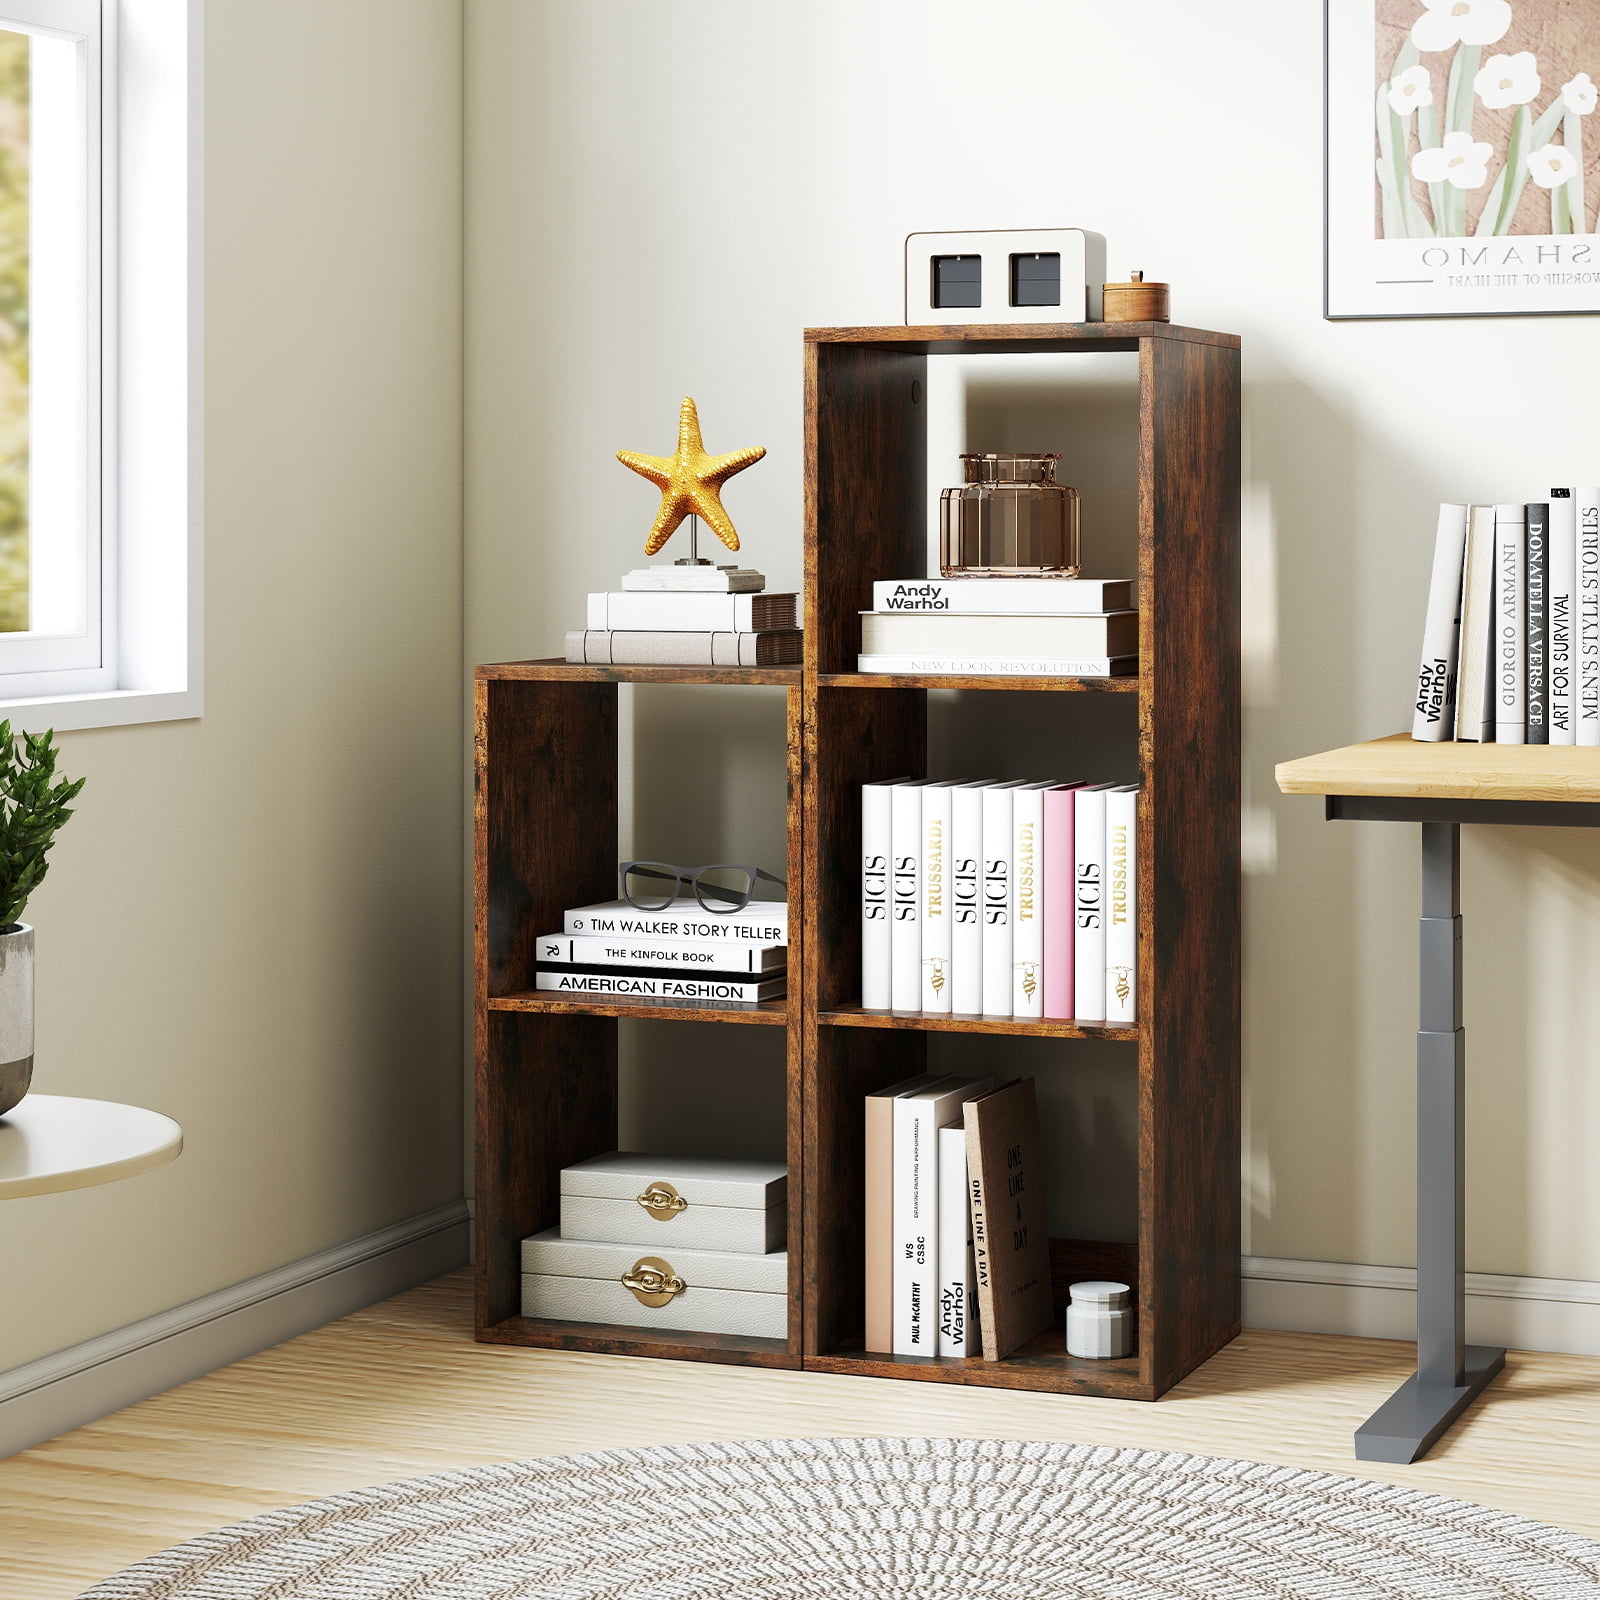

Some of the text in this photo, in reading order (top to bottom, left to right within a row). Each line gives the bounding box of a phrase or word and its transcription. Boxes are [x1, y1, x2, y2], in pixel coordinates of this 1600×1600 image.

[886, 597, 949, 610] Warhol
[894, 584, 941, 599] Andy
[1582, 506, 1599, 721] MEN'S STYLE STORIES
[1502, 543, 1516, 706] GIORGIO ARMANI
[1529, 522, 1543, 726] DONATELLA VERSACE
[911, 661, 1103, 674] NEW LOOK REVOLUTION
[1416, 664, 1434, 714] Andy
[1427, 658, 1447, 723] Warhol
[1552, 593, 1569, 731] ART FOR SURVIVAL
[864, 855, 887, 920] SICIS
[894, 856, 917, 921] SICIS
[927, 819, 942, 918] TRUSSARDI
[955, 858, 978, 924] SICIS
[985, 860, 1008, 925] SICIS
[1019, 822, 1034, 921] TRUSSARDI
[1078, 863, 1102, 929] SICIS
[1112, 825, 1127, 925] TRUSSARDI
[590, 918, 781, 940] TIM WALKER STORY TELLER
[605, 948, 714, 963] THE KINFOLK BOOK
[559, 976, 743, 999] AMERICAN FASHION
[1007, 1144, 1023, 1169] ONE
[1008, 1170, 1025, 1198] LINE
[972, 1179, 989, 1288] ONE LINE A DAY
[1013, 1224, 1028, 1252] DAY
[1016, 1201, 1022, 1221] A
[905, 1242, 914, 1259] WS
[916, 1235, 925, 1265] CSSC
[911, 1281, 921, 1344] PAUL McCARTHY
[940, 1287, 955, 1337] Andy
[953, 1281, 964, 1345] Warhol
